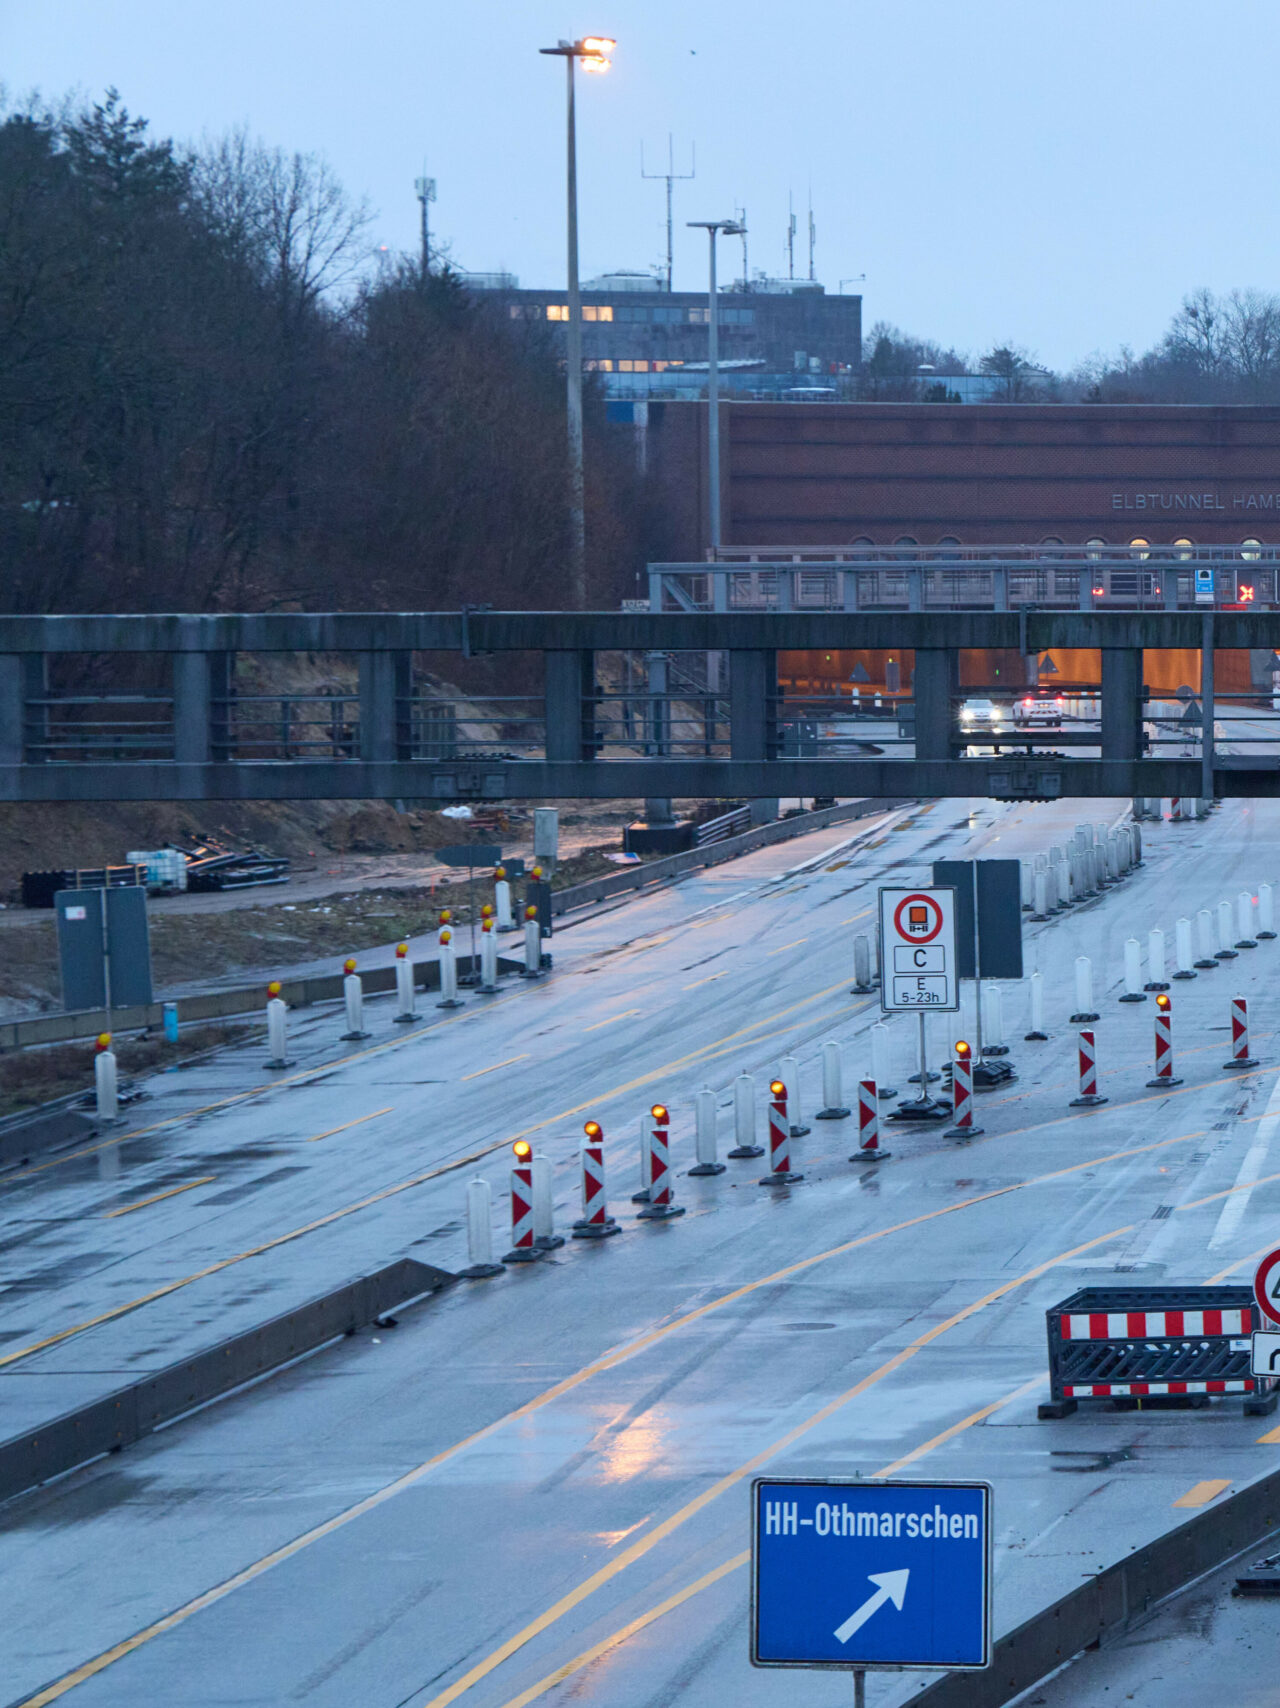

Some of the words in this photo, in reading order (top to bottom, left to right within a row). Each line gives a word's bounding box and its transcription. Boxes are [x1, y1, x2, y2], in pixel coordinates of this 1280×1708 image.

[1111, 494, 1225, 509] ELBTUNNEL
[914, 948, 928, 968] C
[917, 977, 926, 991] E
[901, 992, 940, 1003] 5-23h
[765, 1501, 978, 1539] HH-Othmarschen
